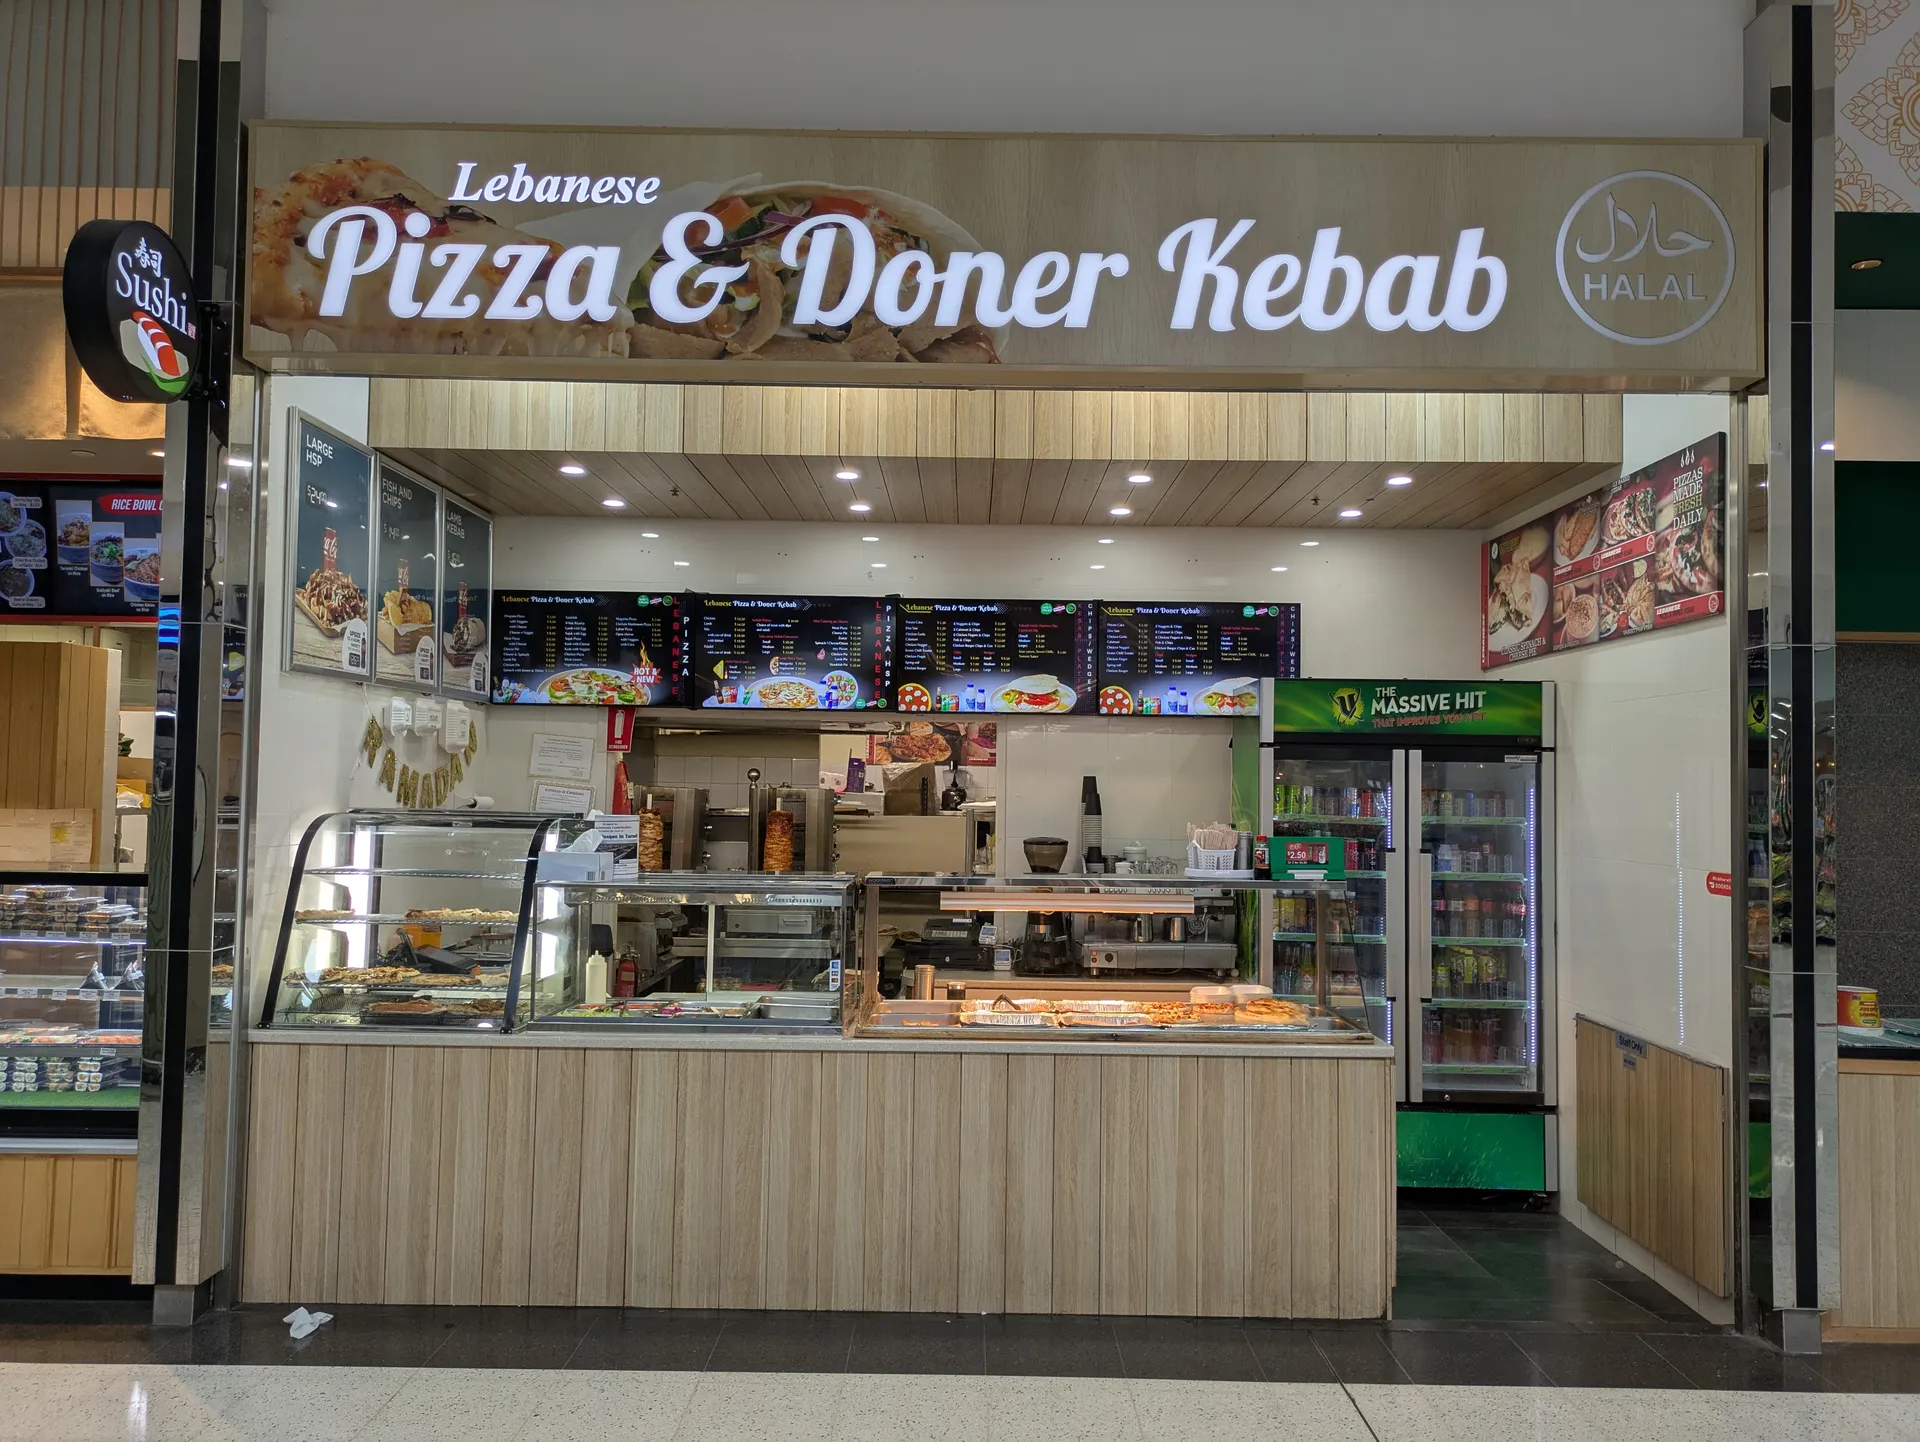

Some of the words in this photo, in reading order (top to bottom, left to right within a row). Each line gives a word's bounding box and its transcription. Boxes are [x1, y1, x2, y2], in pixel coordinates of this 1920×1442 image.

[448, 162, 660, 205] Lebanese
[1576, 191, 1714, 263] حلال
[134, 237, 162, 278] 寿司
[307, 205, 621, 322] Pizza
[648, 211, 750, 324] &
[780, 213, 1129, 329] Doner
[1157, 218, 1508, 332] Kebab
[116, 251, 188, 335] Sushi
[1583, 272, 1708, 301] HALAL
[306, 433, 333, 459] LARGE
[306, 449, 323, 467] HSP
[1673, 467, 1703, 489] PIZZAS
[382, 478, 397, 494] FISH
[398, 485, 412, 500] AND
[1673, 480, 1702, 503] MADE
[111, 499, 130, 510] RICE
[133, 499, 156, 511] BOWL
[382, 492, 402, 509] CHIPS
[1673, 494, 1702, 517] FRESH
[446, 509, 462, 526] LAMB
[1673, 508, 1703, 531] DAILY
[446, 521, 465, 539] KEBAB
[777, 601, 797, 609] Kebab
[1180, 607, 1200, 615] Kebab
[1657, 603, 1681, 615] LEBANESE
[1501, 643, 1521, 655] CLASSIC
[1521, 638, 1542, 652] SPINACH
[1509, 651, 1528, 661] CHEESE
[1529, 648, 1538, 657] PIE
[634, 667, 650, 675] HOT
[1375, 687, 1397, 697] THE
[1371, 693, 1450, 715] MASSIVE
[1455, 691, 1487, 709] HIT
[1372, 718, 1395, 728] THAT
[1396, 715, 1441, 727] IMPROVES
[1443, 714, 1462, 723] YOU
[1473, 712, 1487, 721] BIT
[1287, 850, 1306, 859] $2.50
